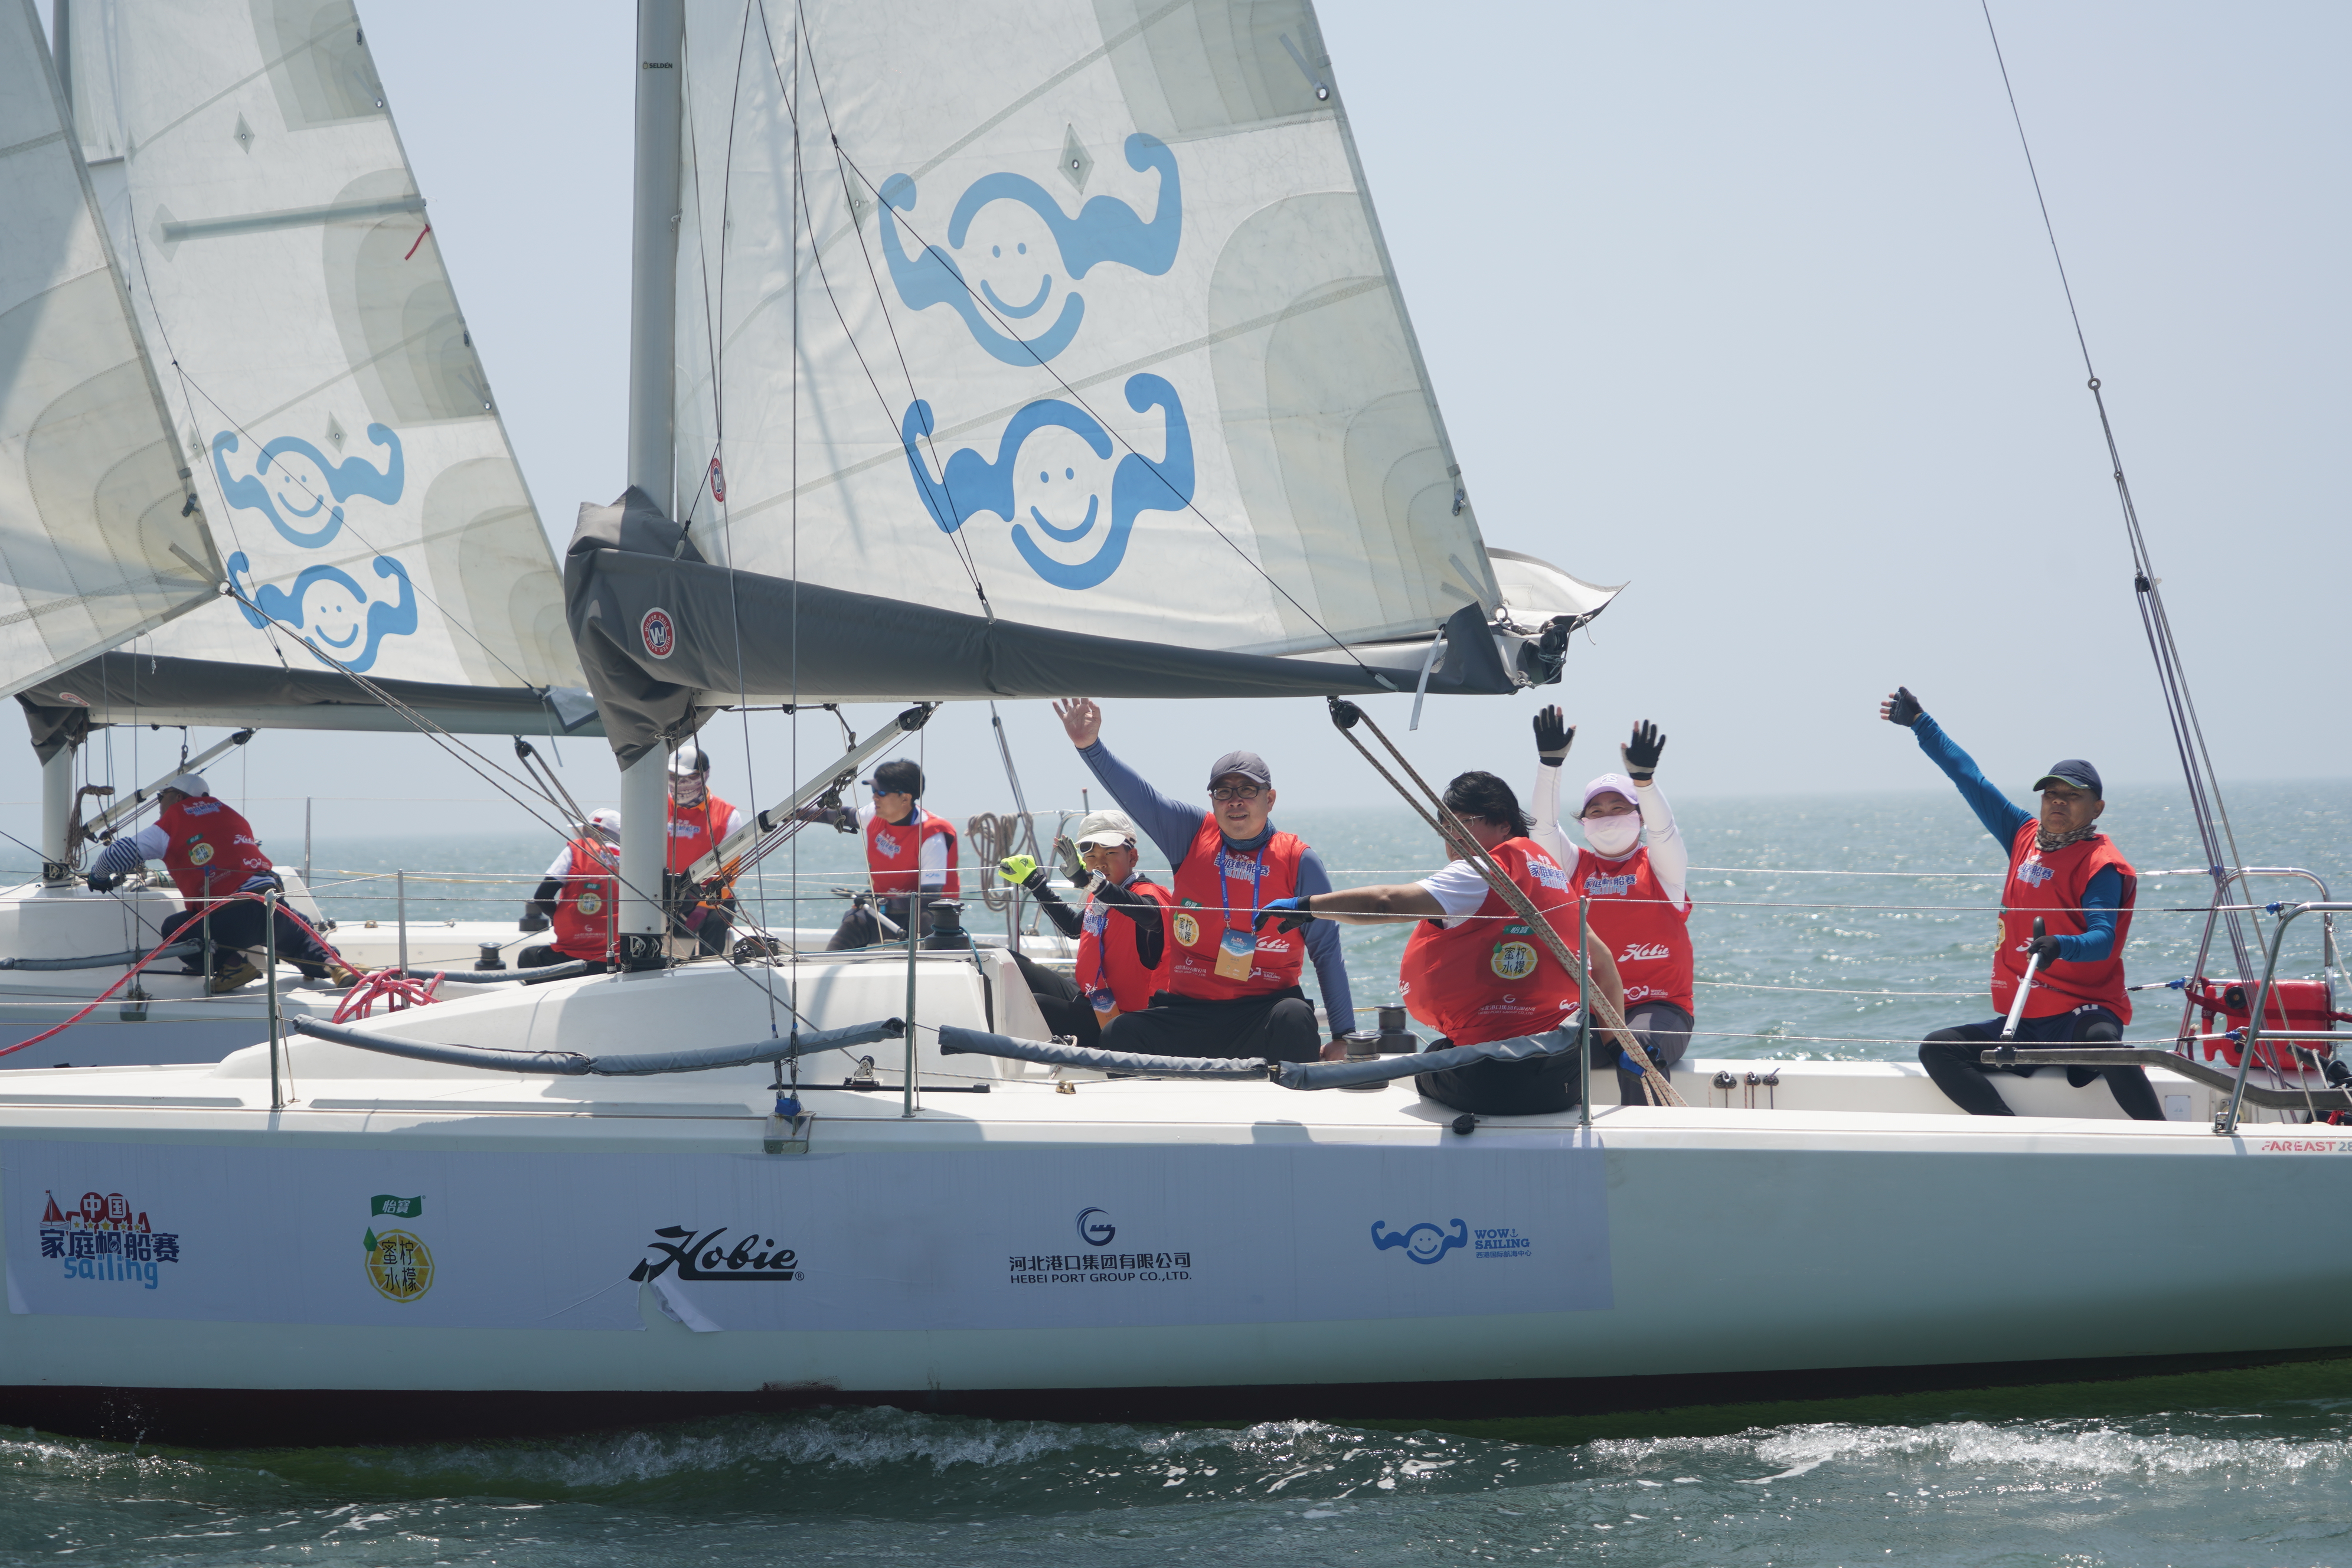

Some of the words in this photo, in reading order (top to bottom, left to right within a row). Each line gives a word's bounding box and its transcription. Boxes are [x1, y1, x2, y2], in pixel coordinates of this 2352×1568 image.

[1589, 884, 1628, 896] sailing
[1617, 942, 1670, 962] Hobie
[2261, 1141, 2337, 1152] FAREAST
[83, 1194, 128, 1219] 中国
[382, 1200, 411, 1214] 怡寶
[1474, 1229, 1510, 1239] WOW
[40, 1228, 180, 1263] 家庭帆船赛
[1475, 1238, 1530, 1250] SAILING
[628, 1225, 798, 1282] Hobie
[1475, 1250, 1532, 1259] 西港国际航海中心
[1009, 1252, 1191, 1272] 河北港口集团有限公司
[64, 1253, 158, 1290] sailing
[1010, 1274, 1047, 1283] HEBEI
[1051, 1273, 1086, 1283] PORT
[1090, 1273, 1135, 1282] GROUP
